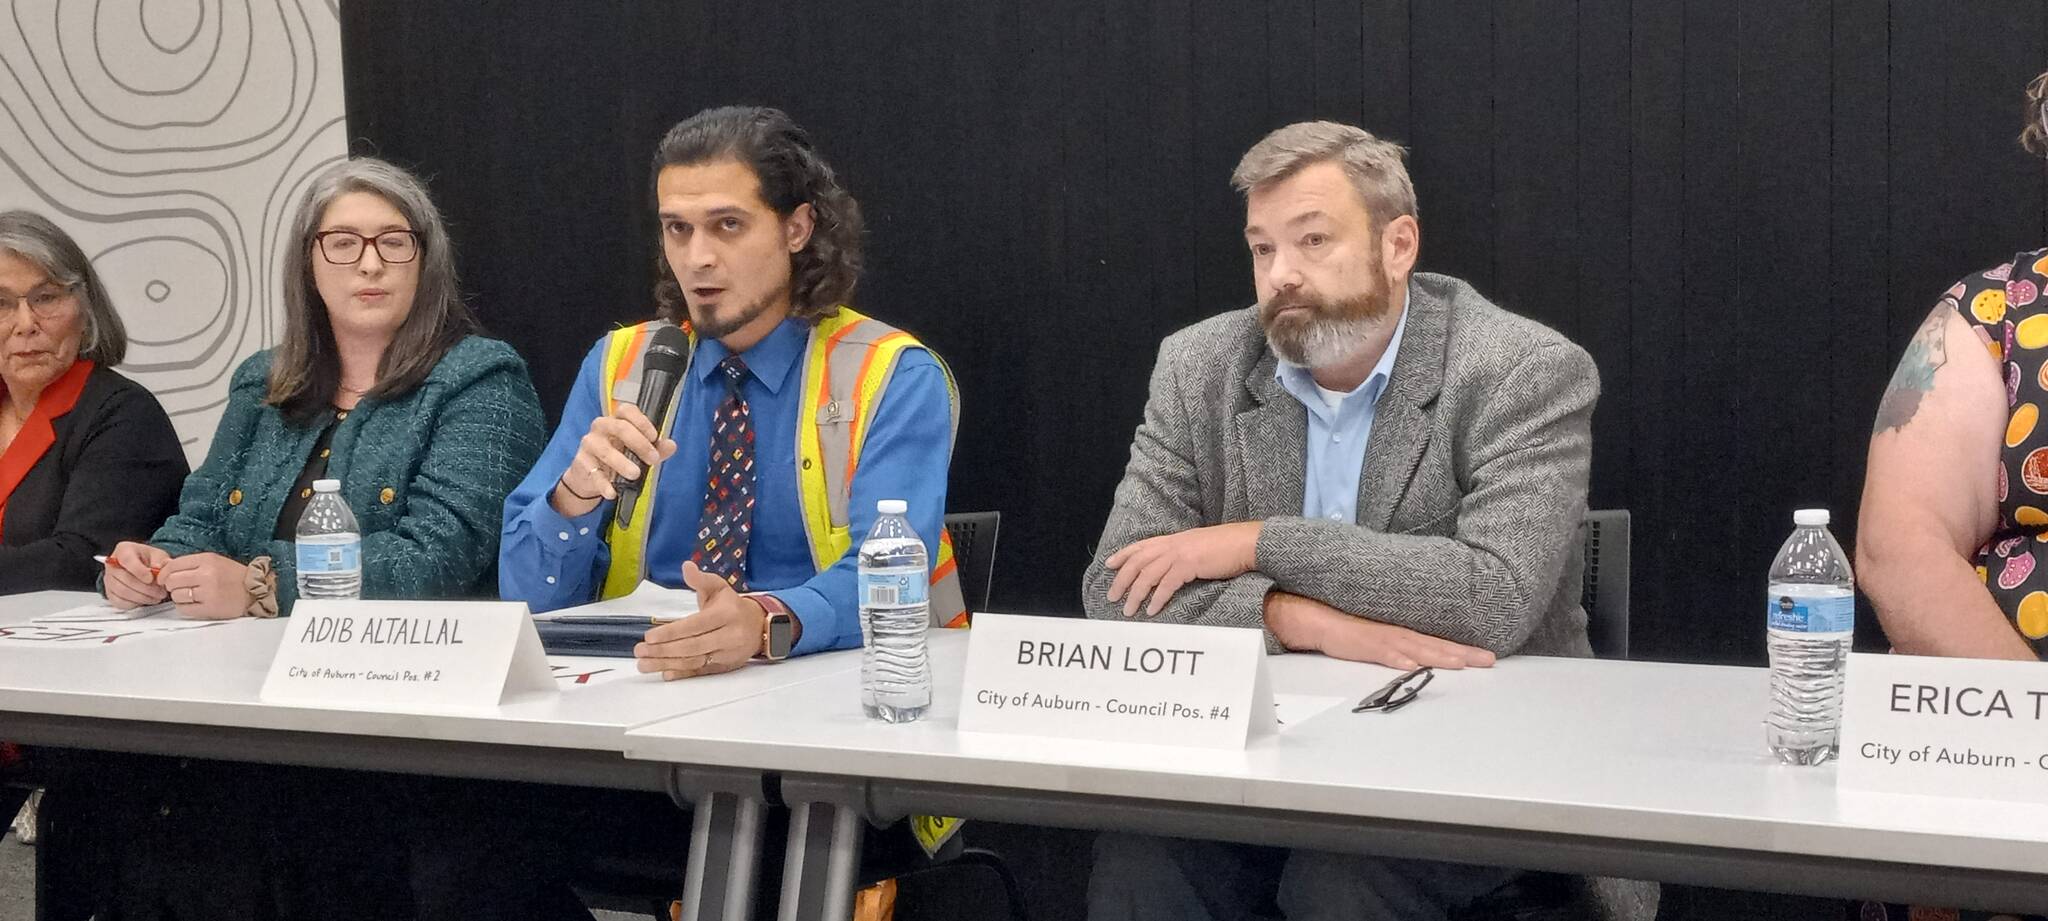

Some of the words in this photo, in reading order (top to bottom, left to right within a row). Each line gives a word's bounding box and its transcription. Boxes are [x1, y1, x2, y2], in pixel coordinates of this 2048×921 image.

[300, 616, 353, 643] ADIB
[359, 617, 464, 645] ALTALLAL
[288, 665, 308, 679] City
[311, 667, 321, 678] of
[322, 667, 356, 680] Auburn
[366, 670, 400, 681] Council
[1017, 640, 1112, 671] BRIAN
[1123, 647, 1205, 676] LOTT
[976, 689, 1008, 710] City
[1011, 691, 1030, 707] of
[1031, 693, 1091, 712] Auburn
[1106, 698, 1168, 717] Council
[1171, 703, 1204, 720] Pos.
[1209, 705, 1230, 721] #4
[1890, 683, 2014, 720] ERICA
[1860, 742, 1902, 766] City
[1908, 745, 1932, 763] of
[1935, 747, 2016, 769] Auburn
